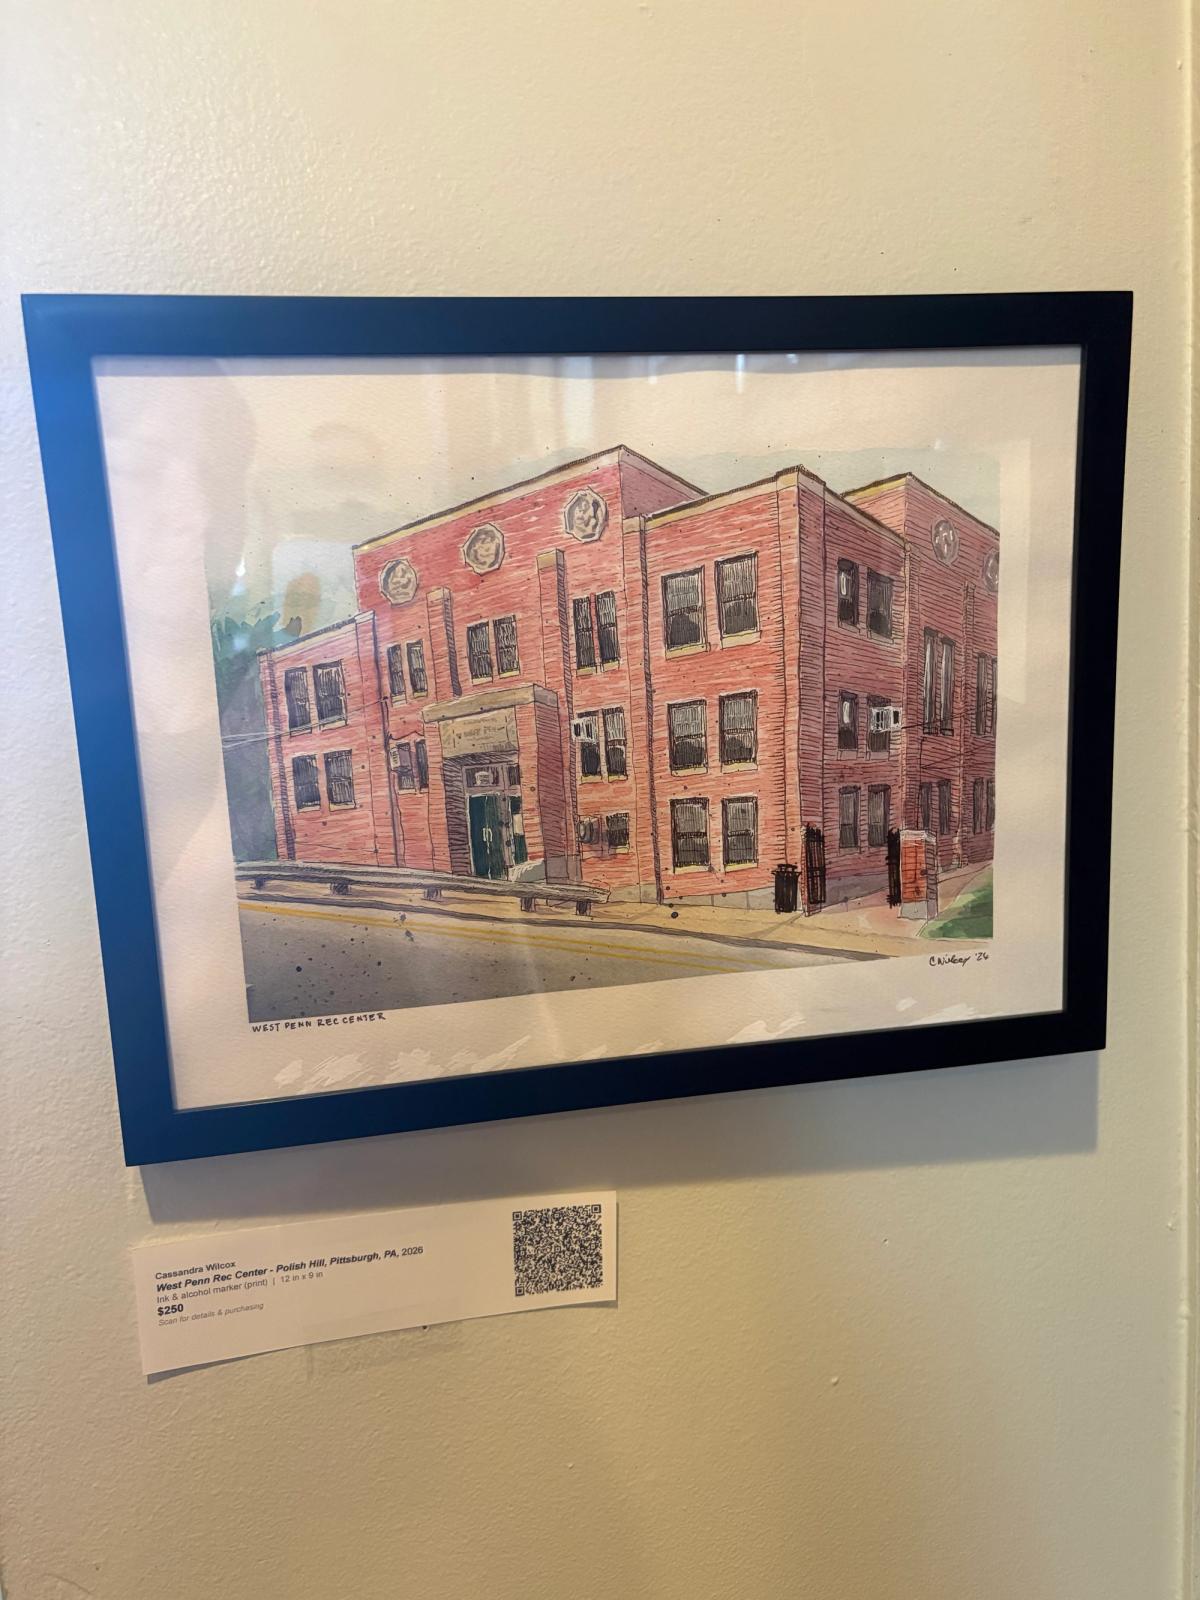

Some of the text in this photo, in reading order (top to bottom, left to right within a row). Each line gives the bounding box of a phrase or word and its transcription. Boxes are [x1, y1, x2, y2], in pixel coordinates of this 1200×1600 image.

[252, 1012, 386, 1032] WEST PENN REC CENTER
[156, 1281, 182, 1292] West
[184, 1277, 210, 1287] Penn
[213, 1274, 232, 1283] Rec
[235, 1268, 268, 1279] Center
[276, 1262, 306, 1273] Polish
[309, 1259, 328, 1268] Hill,
[329, 1252, 381, 1265] Pittsburgh,
[384, 1250, 399, 1259] PA,
[401, 1246, 424, 1256] 2026
[156, 1261, 236, 1280] Cassandra Wilcox
[181, 1289, 211, 1299] alcohol
[212, 1283, 242, 1294] marker
[244, 1279, 268, 1290] (print)
[157, 1304, 184, 1316] $250
[191, 1311, 215, 1321] details
[224, 1303, 264, 1317] purchasing
